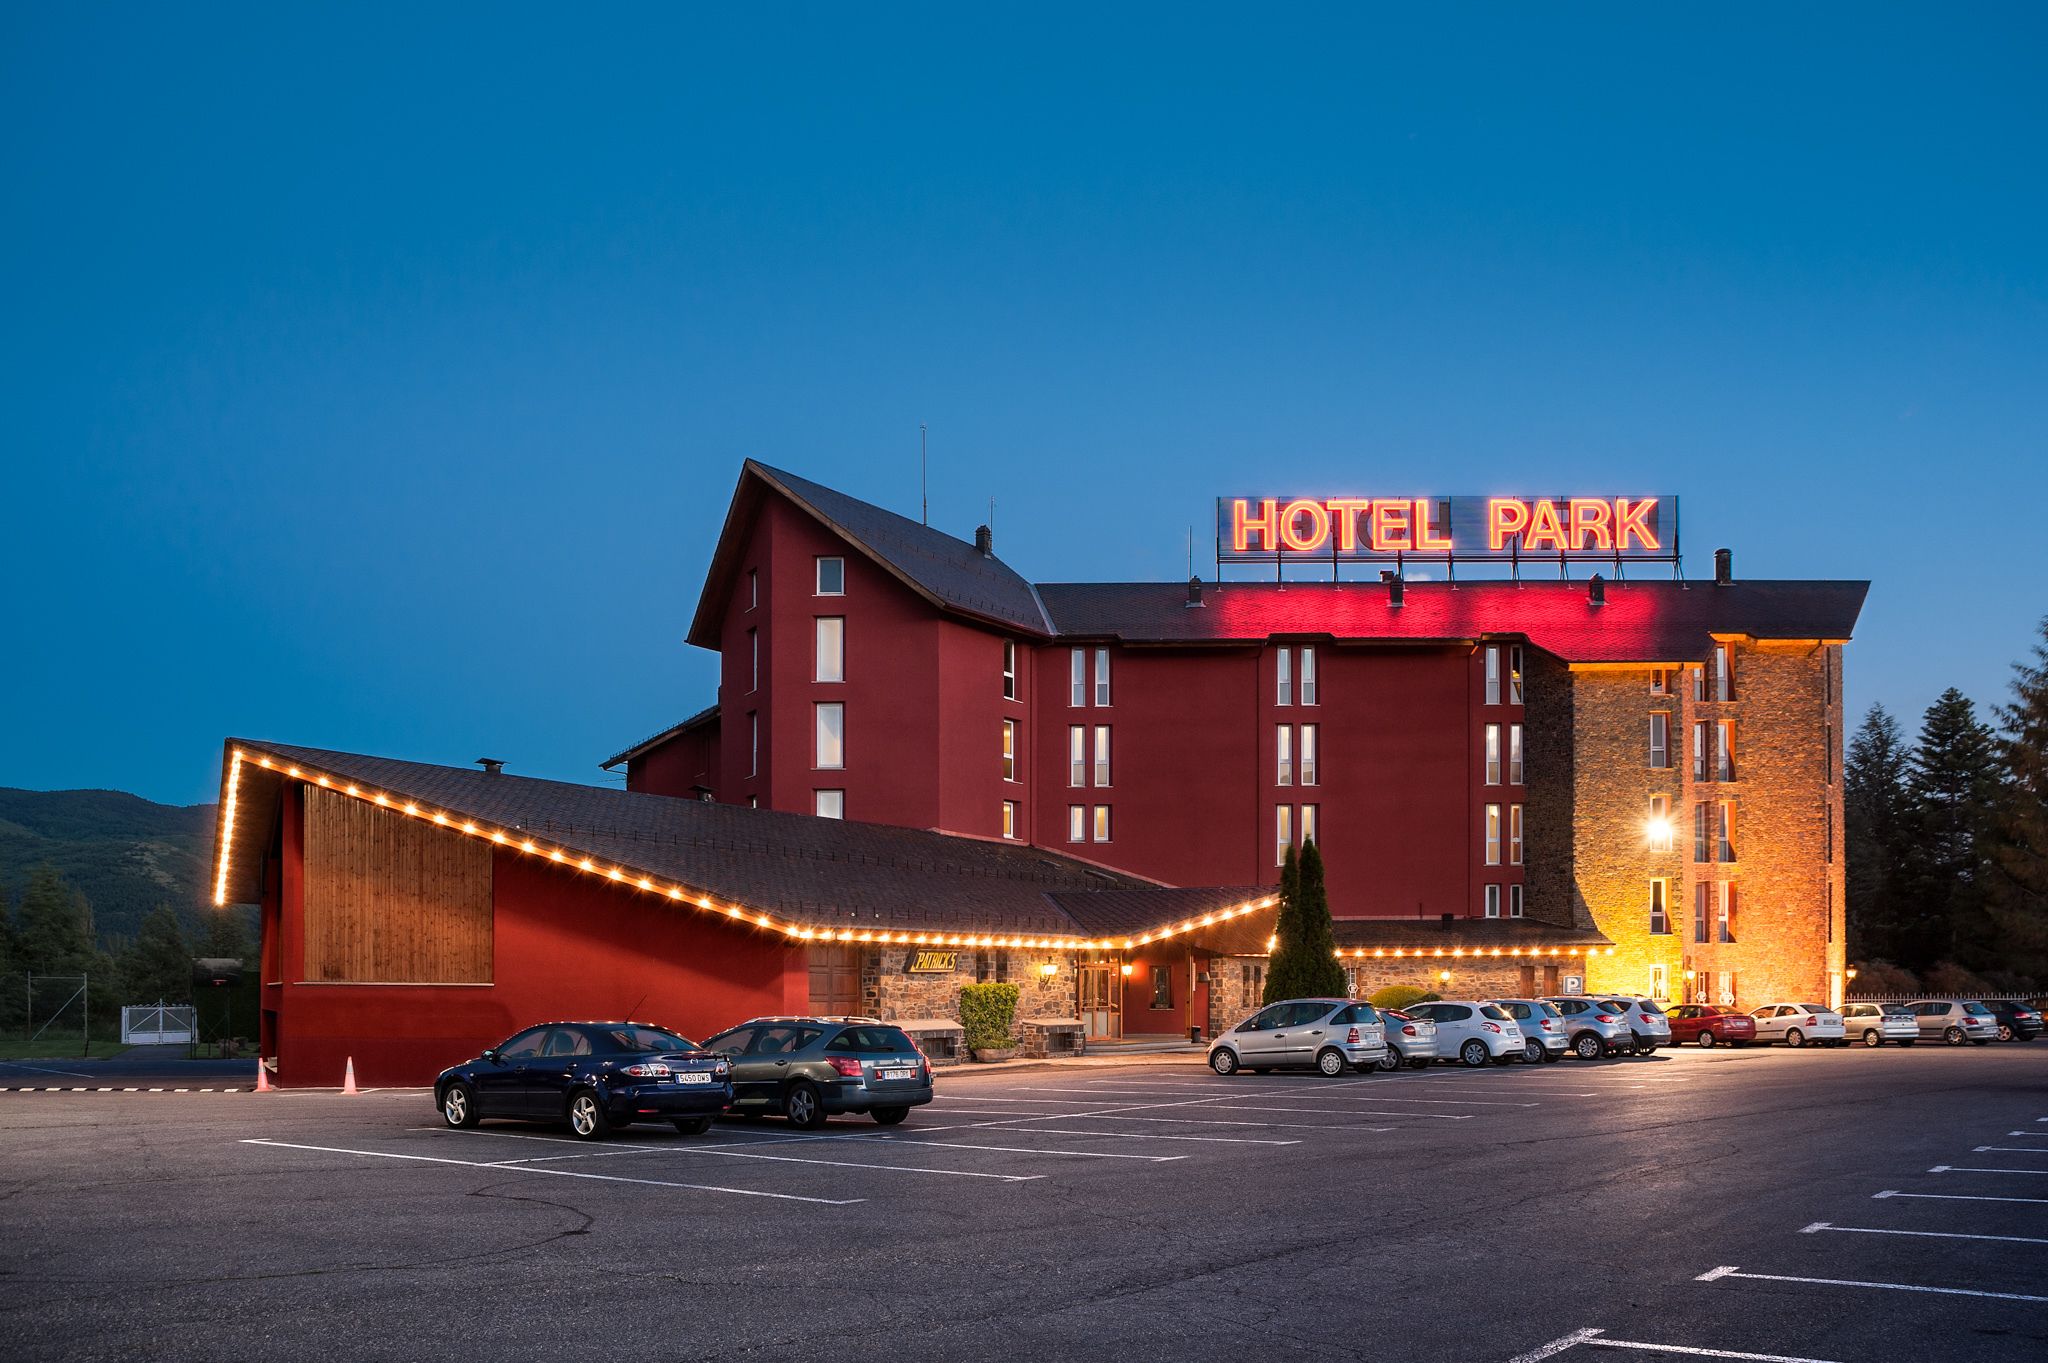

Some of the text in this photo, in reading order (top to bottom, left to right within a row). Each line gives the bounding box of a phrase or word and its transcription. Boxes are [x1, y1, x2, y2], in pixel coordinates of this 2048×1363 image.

[1233, 498, 1661, 551] HOTEL PARK
[1567, 978, 1579, 993] P
